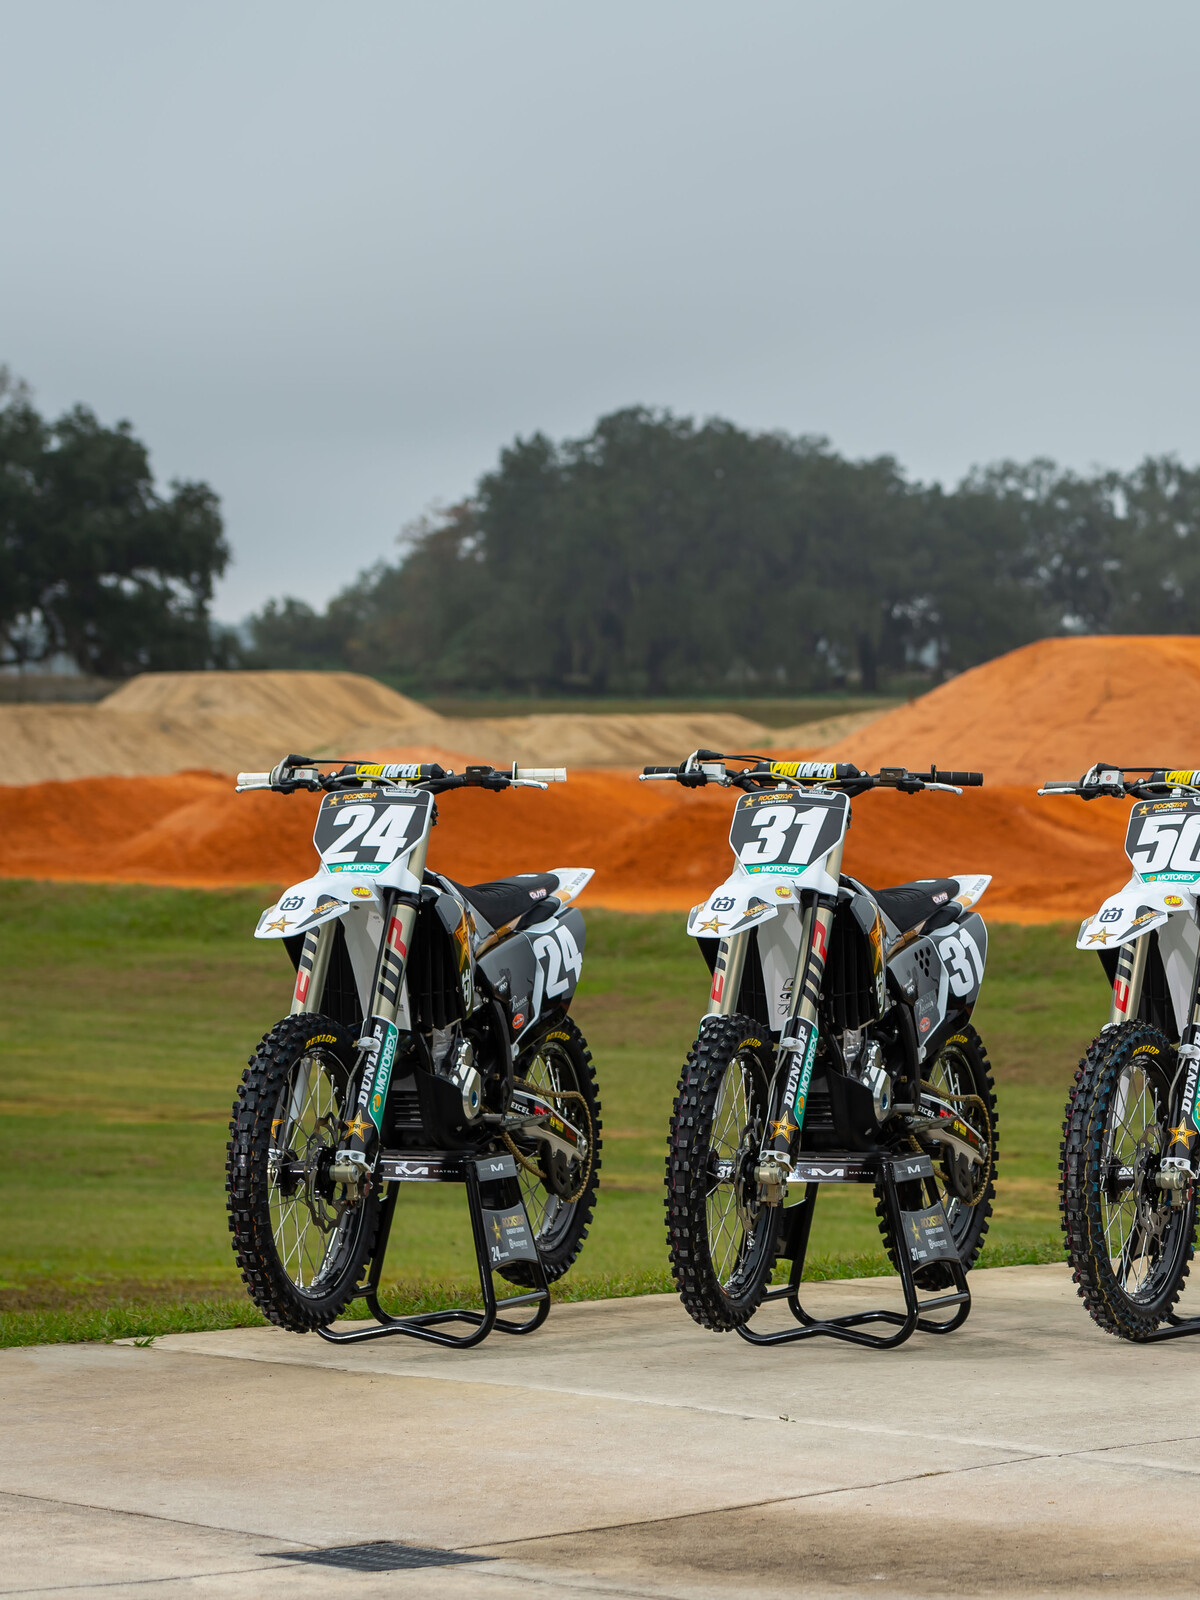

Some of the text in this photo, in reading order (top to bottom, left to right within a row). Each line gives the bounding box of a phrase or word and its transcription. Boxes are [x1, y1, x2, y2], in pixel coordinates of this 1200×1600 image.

[773, 762, 834, 778] PROTAPER
[343, 792, 377, 800] ROCKSTAR
[758, 793, 793, 802] ROCKSTAR
[1152, 802, 1188, 810] ROCKSTAR
[321, 804, 416, 864] 24
[740, 806, 829, 865] 31
[343, 864, 381, 872] MOTOREX
[1157, 873, 1195, 881] MOTOREX
[532, 925, 583, 999] 24
[938, 928, 984, 998] 31
[305, 1034, 337, 1049] DUNLOP
[545, 1031, 571, 1043] DUNLOP
[737, 1037, 762, 1050] DUNLOP
[1132, 1045, 1160, 1058] DUNLOP
[358, 1024, 384, 1108] DUNLP
[375, 1031, 397, 1094] MOTOREX
[799, 1033, 818, 1097] MOTOREX
[510, 1101, 530, 1115] EXCEL
[716, 1166, 732, 1179] 31
[491, 1246, 501, 1262] 24
